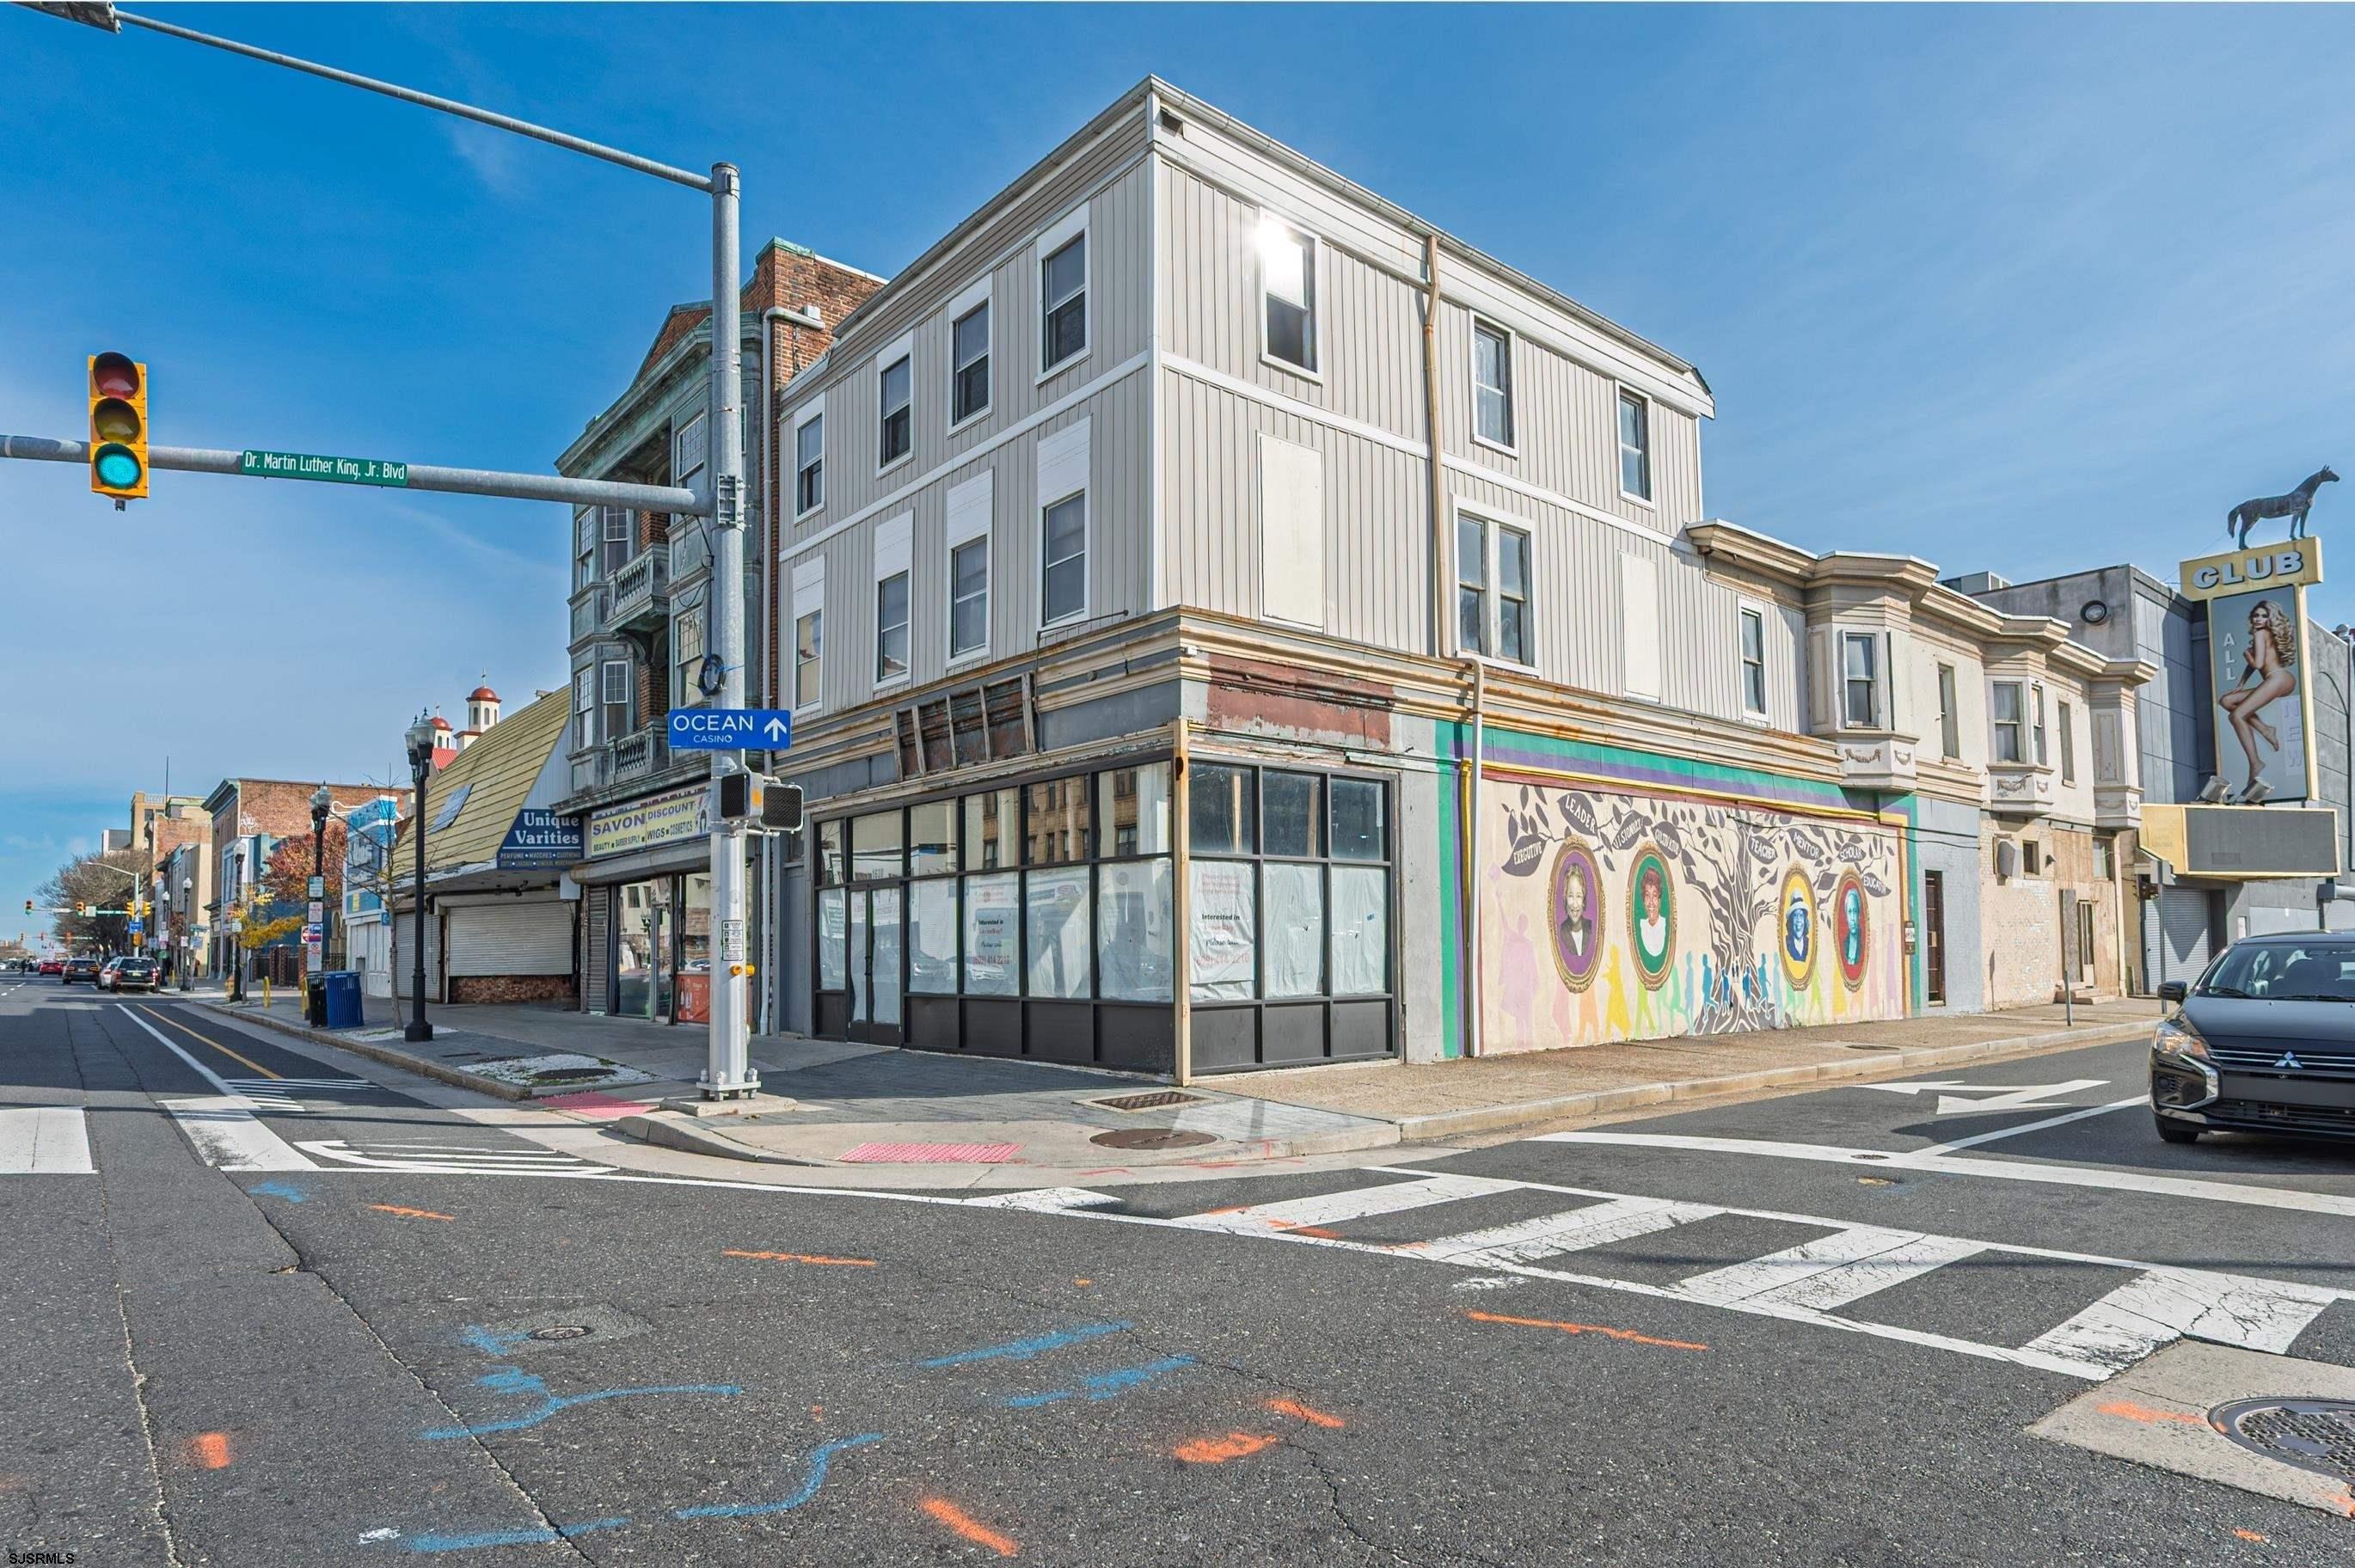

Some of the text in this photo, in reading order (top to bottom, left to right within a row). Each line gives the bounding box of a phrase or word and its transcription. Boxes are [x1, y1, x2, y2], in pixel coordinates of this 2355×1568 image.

[245, 451, 405, 481] Dr. Martin Luther King, Jr. Blvd
[2192, 550, 2304, 590] CLUB
[2223, 632, 2236, 681] ALL
[673, 714, 753, 732] OCEAN
[2284, 700, 2303, 768] NEW
[693, 734, 733, 744] CASINO
[523, 812, 580, 830] Unique
[592, 800, 696, 836] SAVON DISCOUNT
[1565, 794, 1596, 834] LEADER
[515, 830, 580, 844] Varities
[593, 842, 610, 852] BEAUTY
[647, 827, 665, 841] WIGS
[670, 820, 693, 836] COSMETICS
[1613, 818, 1642, 848] VISIONARY
[1793, 831, 1819, 859] MENTOR
[1513, 841, 1543, 866] EXECUTIVE
[1751, 837, 1777, 860] TEACHER
[1839, 846, 1863, 861] SCHOLAR
